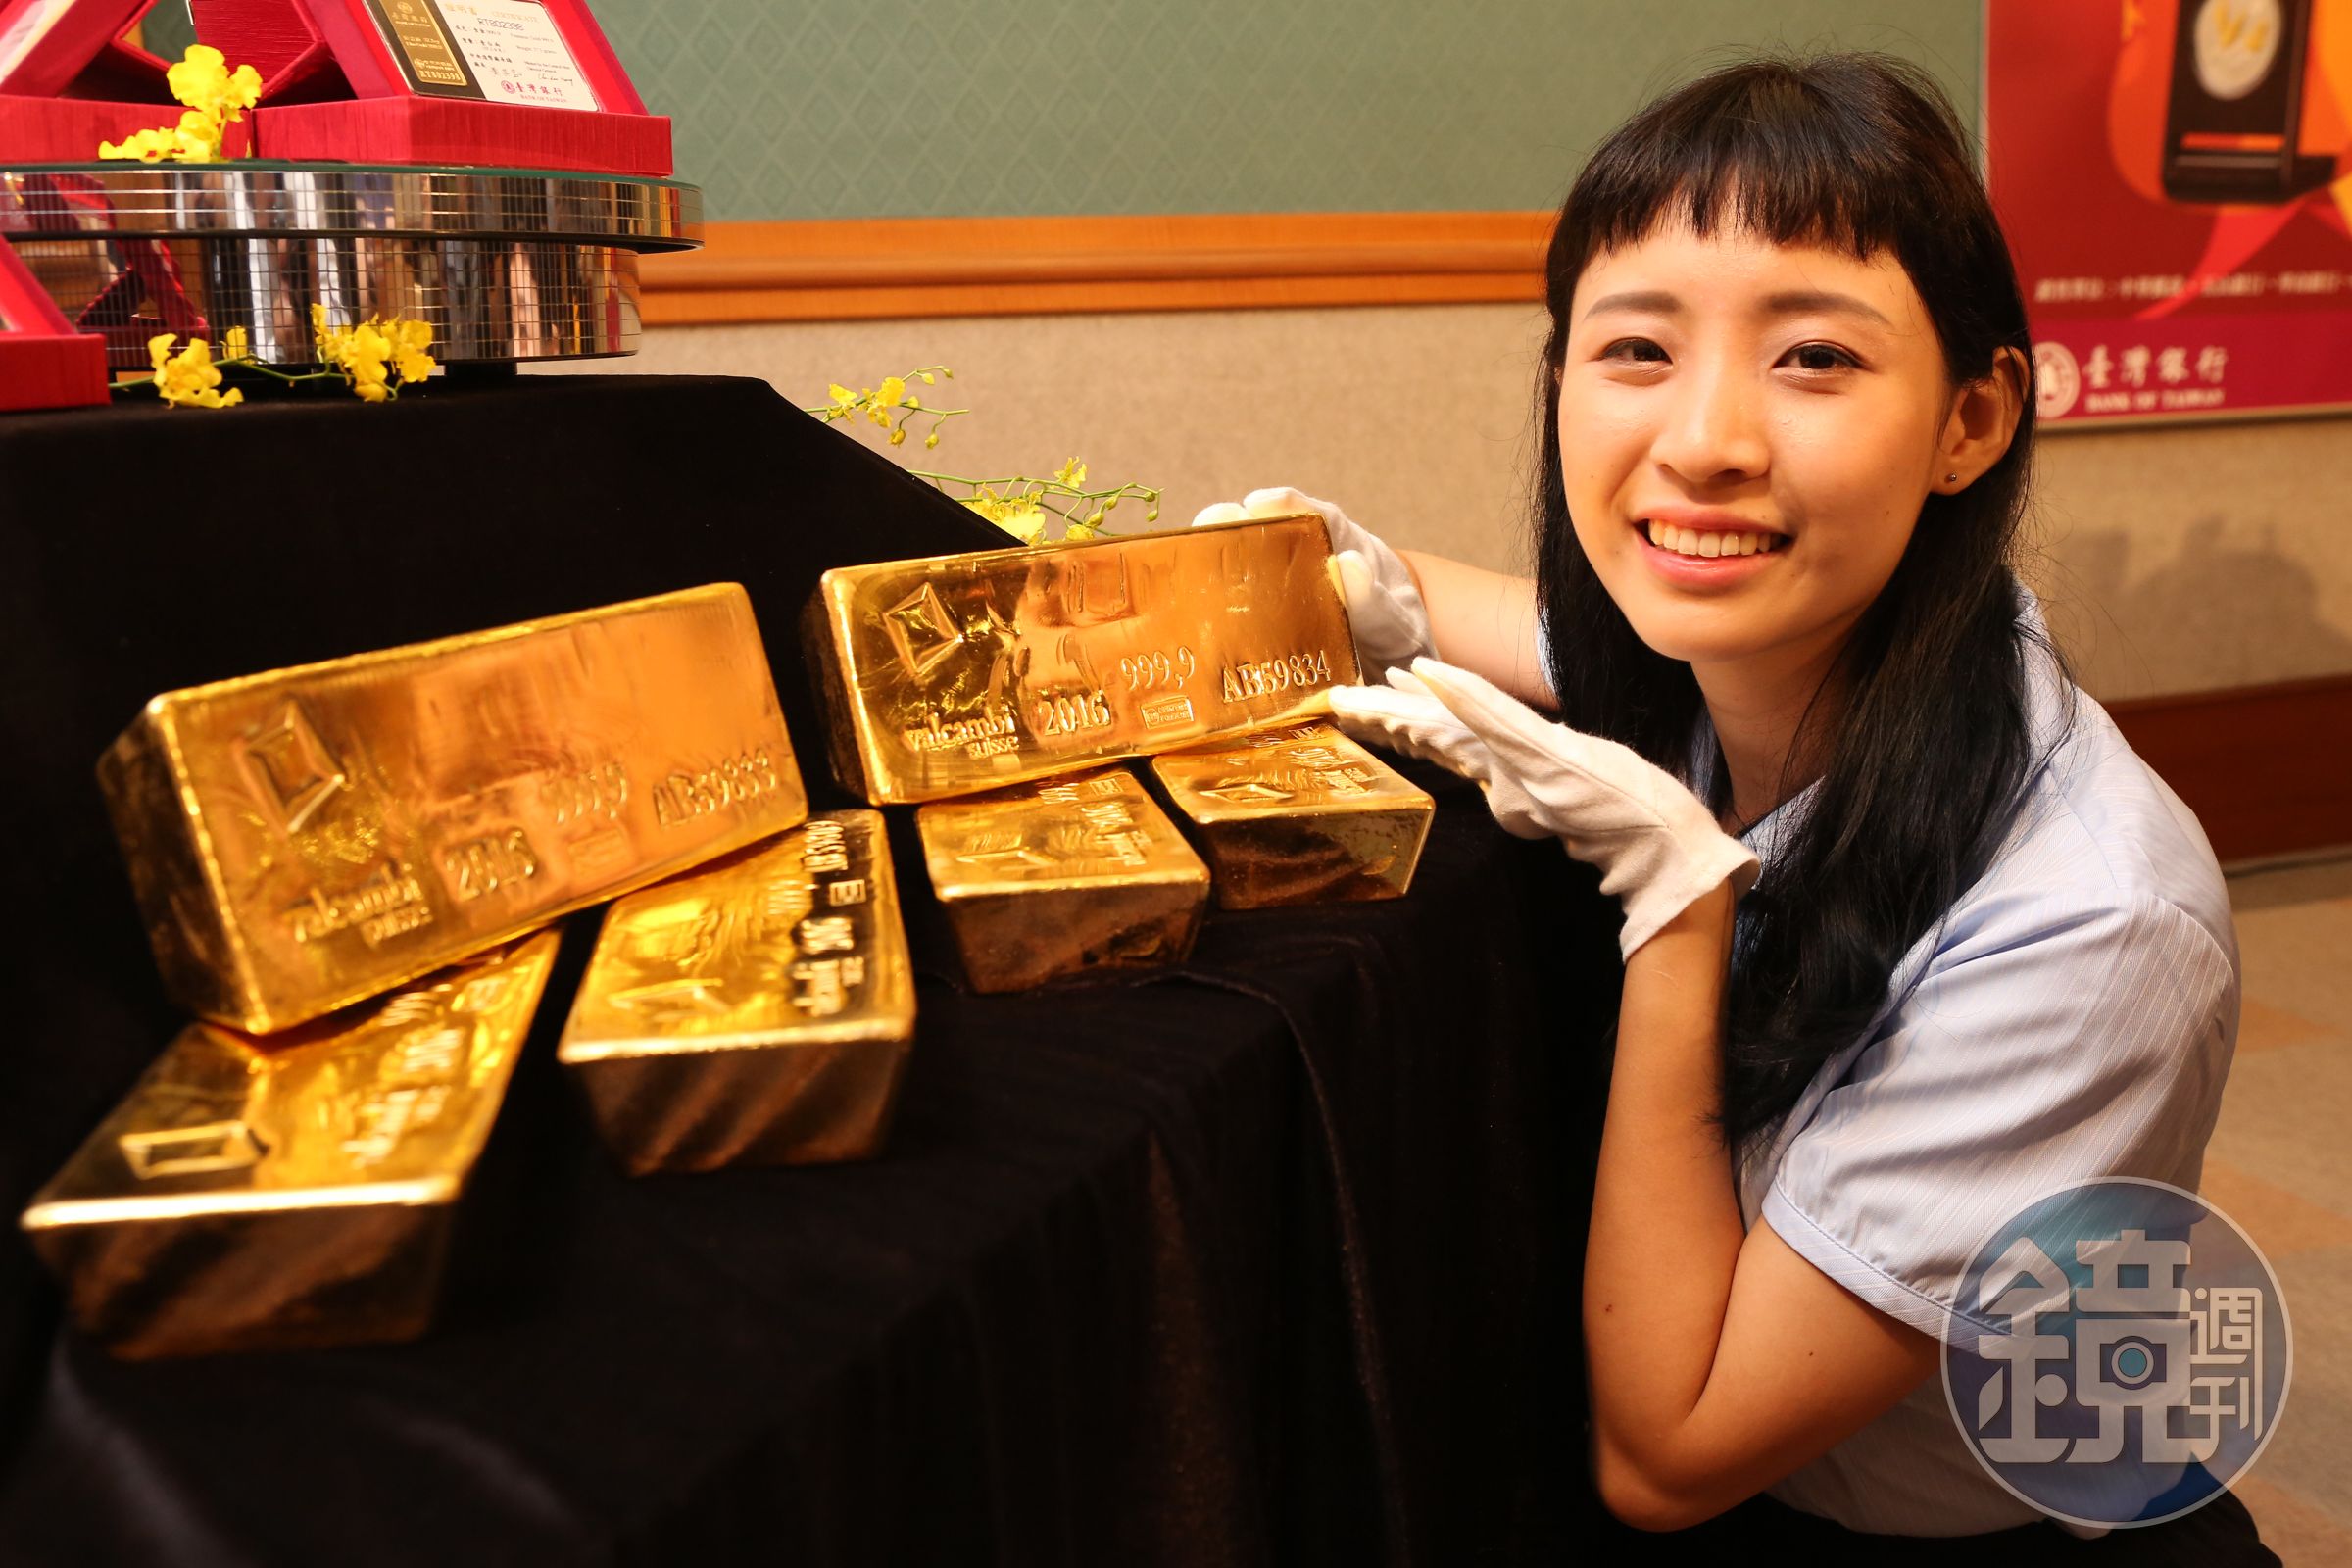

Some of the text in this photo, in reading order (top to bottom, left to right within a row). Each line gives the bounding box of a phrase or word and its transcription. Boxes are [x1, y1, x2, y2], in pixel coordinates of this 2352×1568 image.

[1223, 649, 1331, 704] AB59834
[903, 704, 1016, 752] valcambi
[1037, 689, 1112, 736] 2016
[966, 735, 1020, 760] suisse
